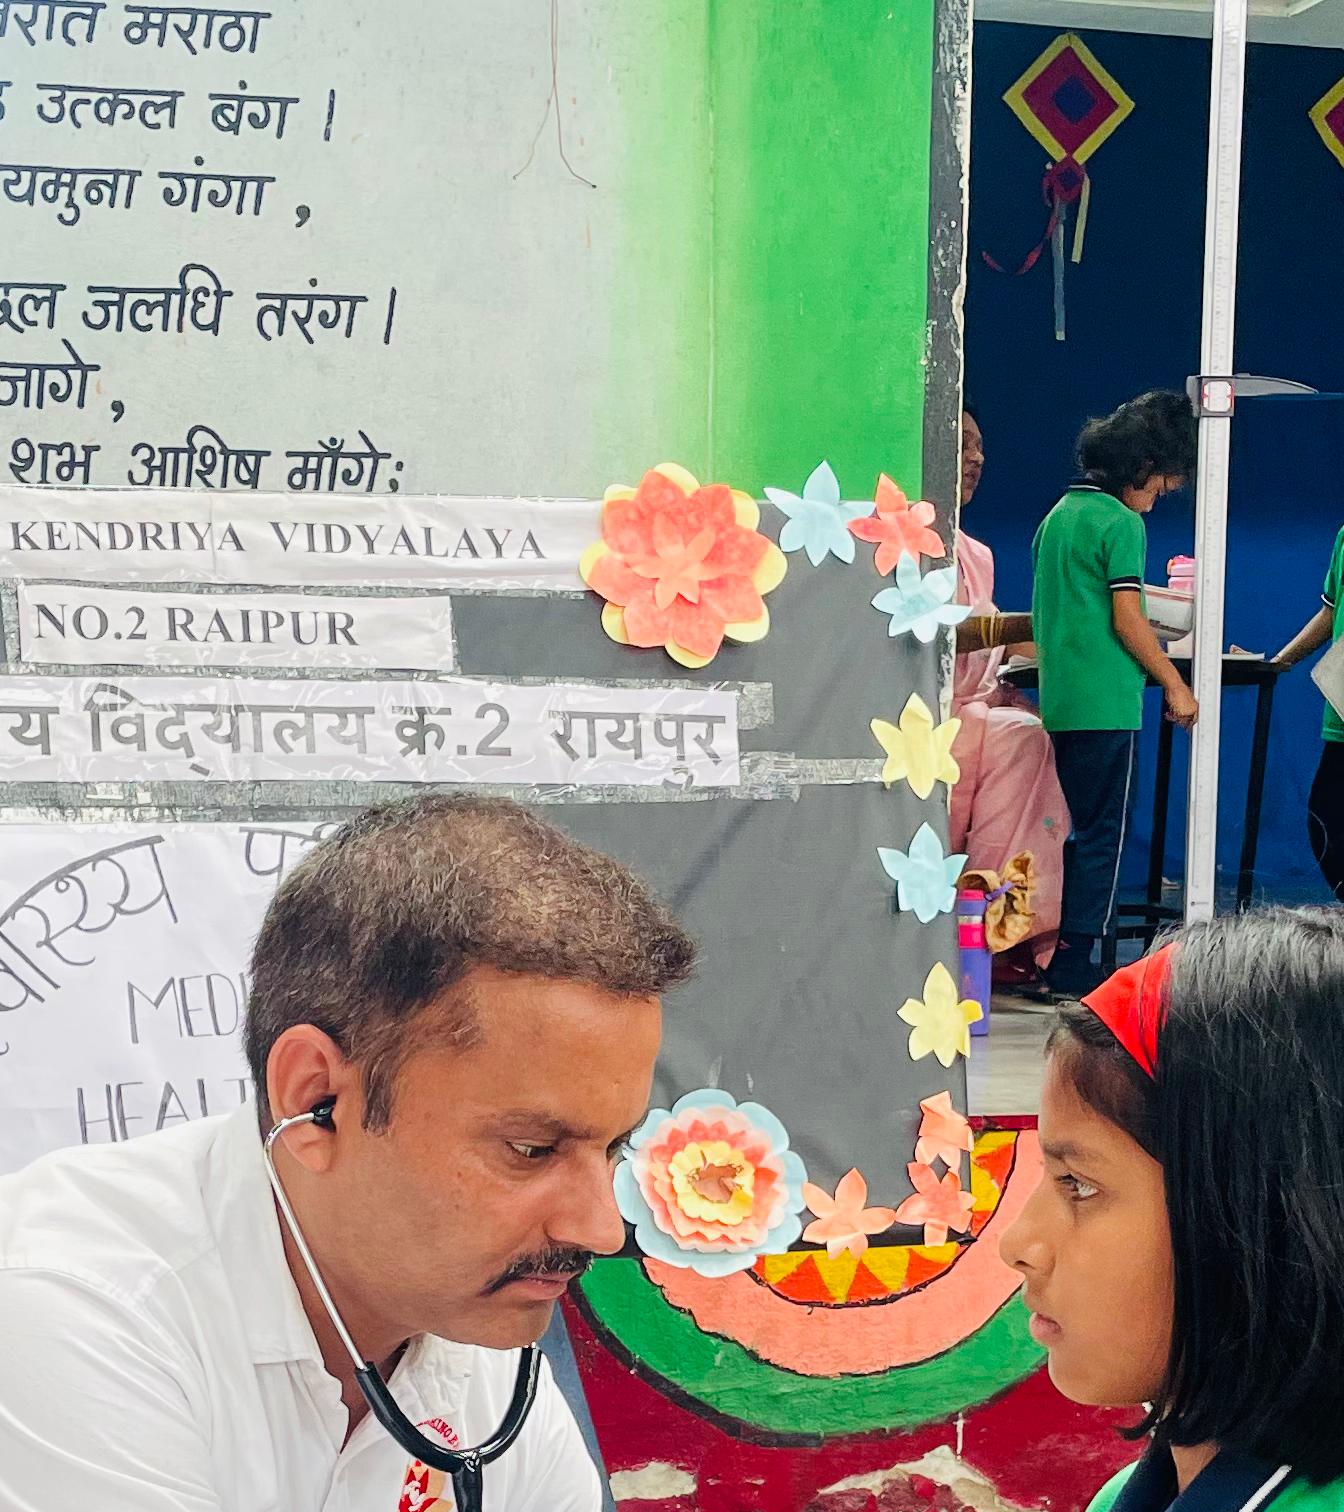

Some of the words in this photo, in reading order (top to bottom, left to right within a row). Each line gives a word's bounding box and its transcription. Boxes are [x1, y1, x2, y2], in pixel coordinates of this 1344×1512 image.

[123, 4, 274, 56] मराठा
[35, 82, 186, 131] उत्कल
[208, 79, 301, 140] बंग
[80, 263, 234, 338] जलधि
[254, 277, 369, 346] तरंग
[126, 424, 273, 489] आशिष
[11, 520, 248, 555] KENDRIYA
[267, 521, 548, 561] VIDYALAYA
[34, 602, 149, 642] NO.2
[165, 603, 361, 647] RAIPUR
